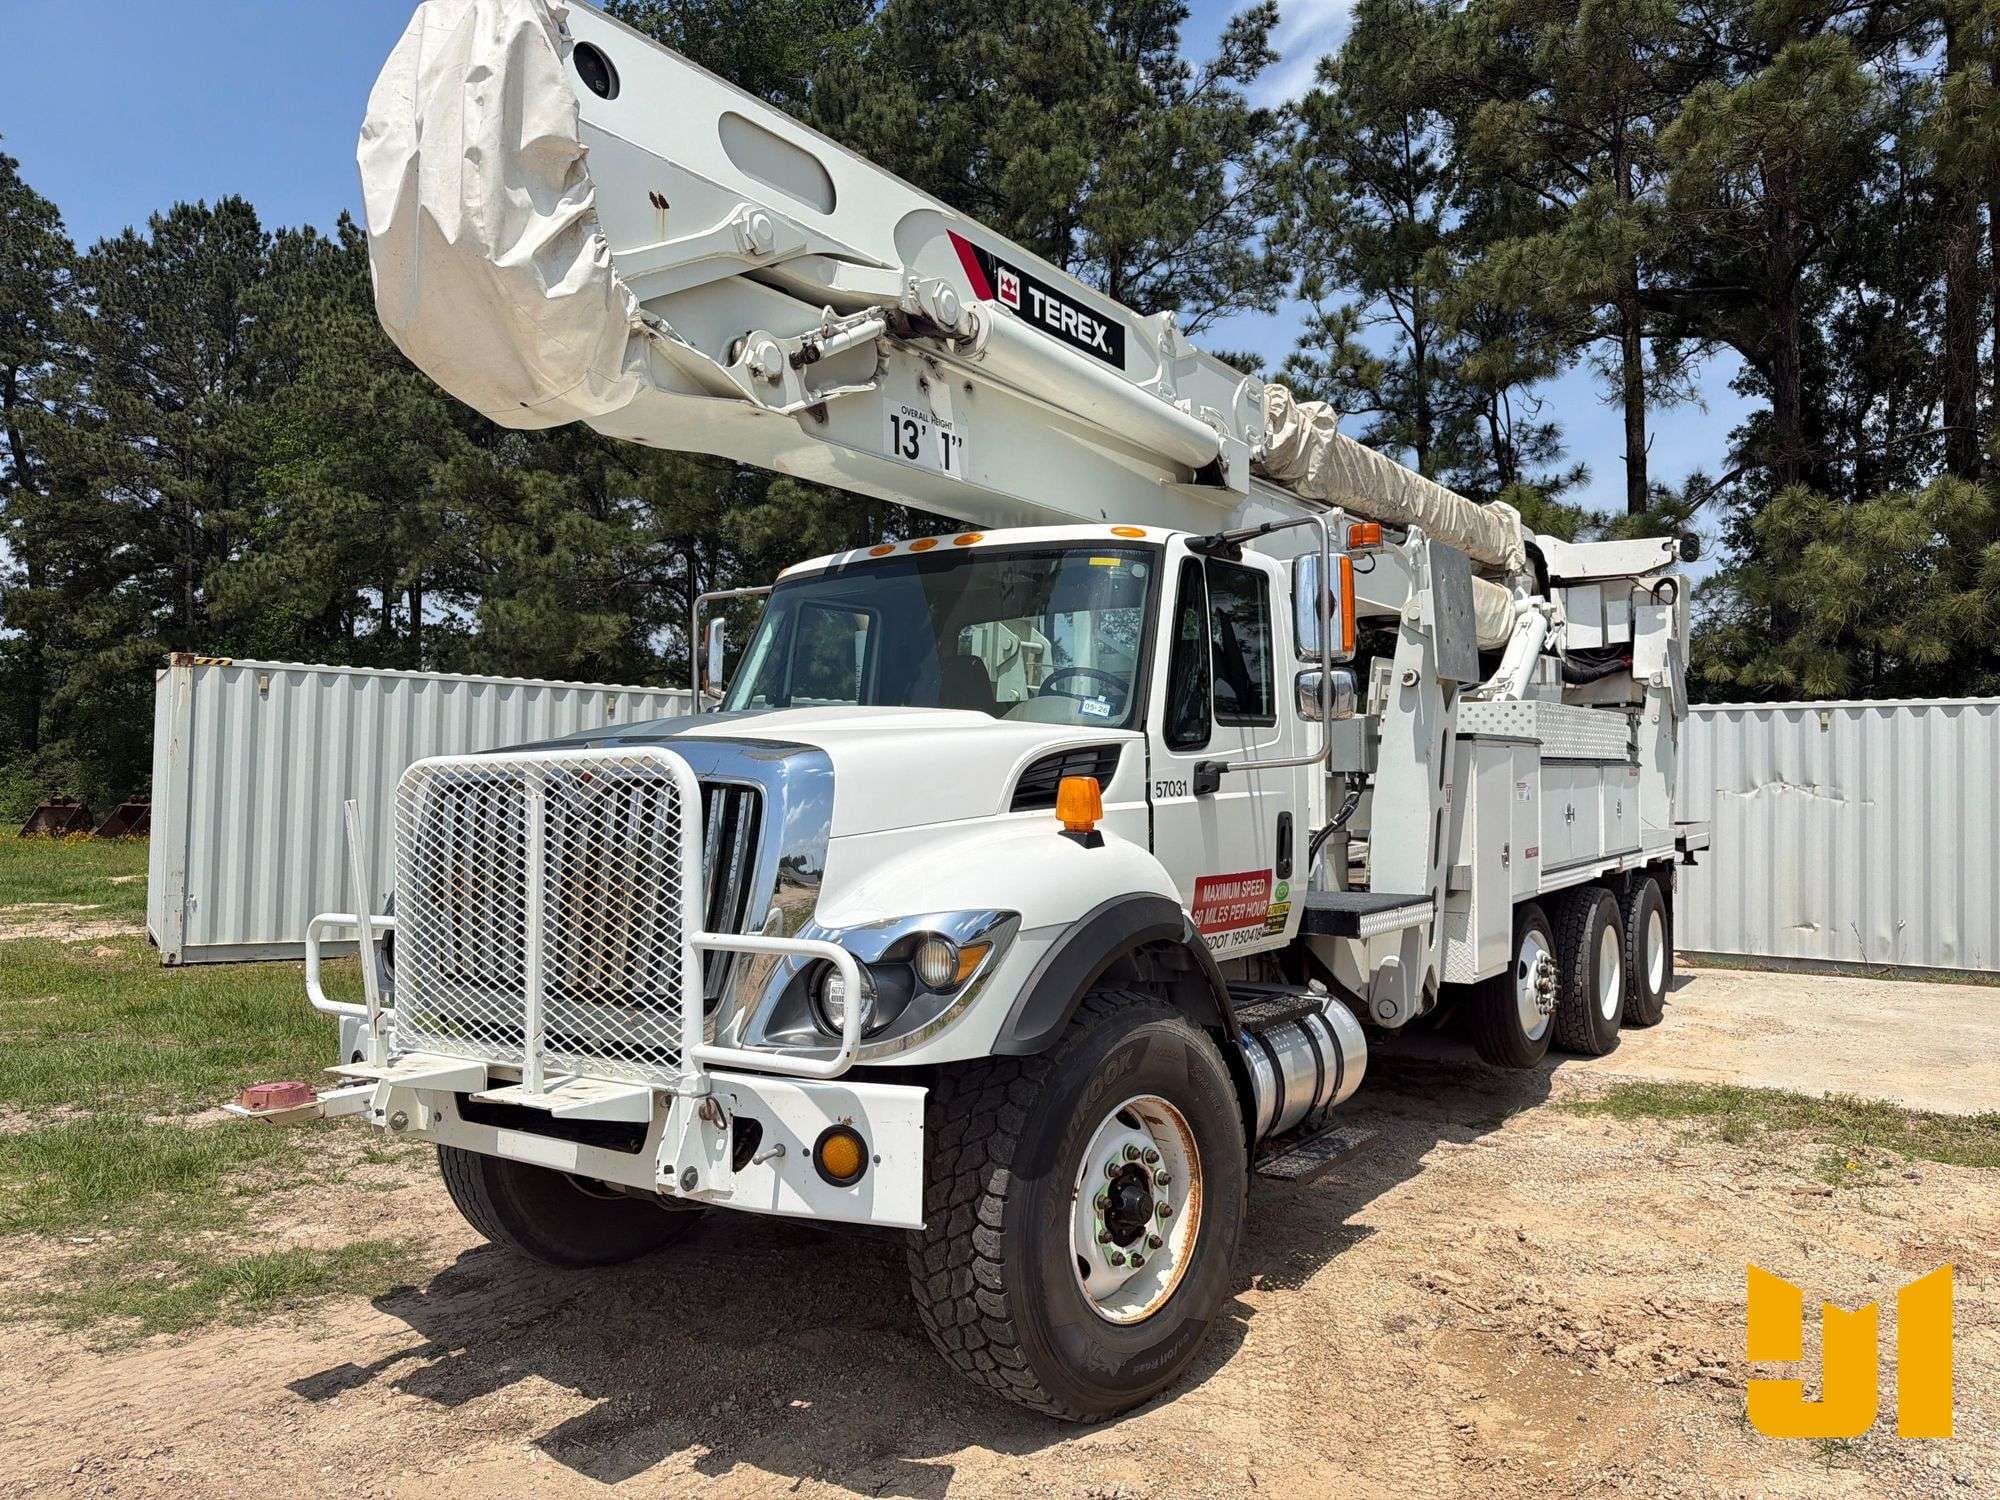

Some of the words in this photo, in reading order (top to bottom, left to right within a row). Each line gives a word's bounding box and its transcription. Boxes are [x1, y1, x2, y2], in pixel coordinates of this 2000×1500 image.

[1028, 286, 1108, 353] TEREX
[901, 405, 930, 423] OVERALL
[931, 415, 953, 431] HEIGHT
[1155, 780, 1187, 798] 57031
[1203, 882, 1240, 902] MAXIMUM
[1241, 879, 1265, 897] SPEED
[1204, 905, 1229, 924] MILES
[1229, 903, 1246, 921] PER
[1245, 900, 1267, 918] HOUR
[1203, 933, 1230, 950] SDOT
